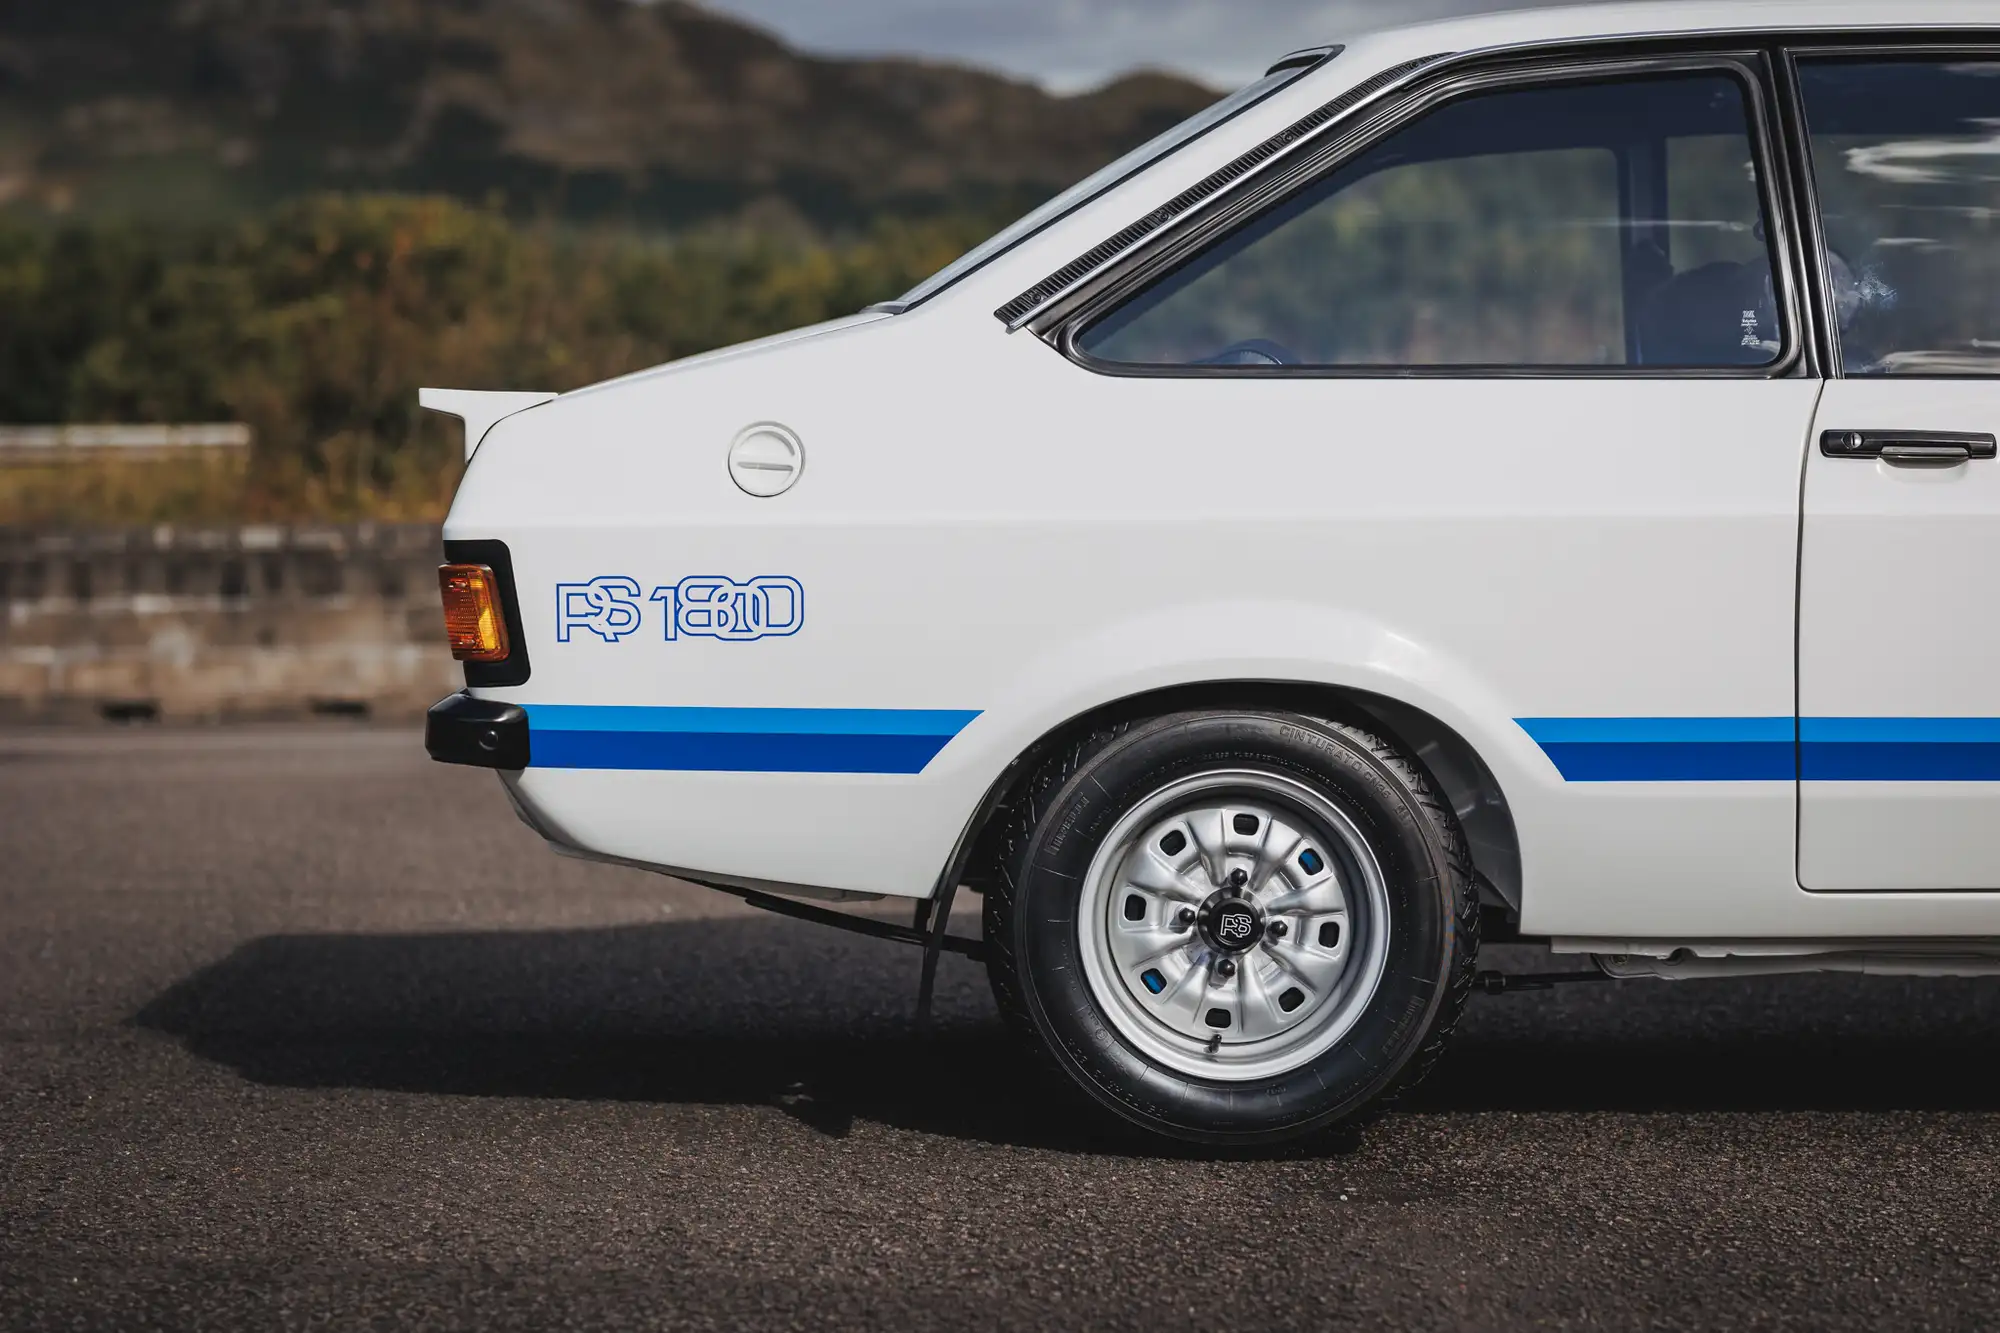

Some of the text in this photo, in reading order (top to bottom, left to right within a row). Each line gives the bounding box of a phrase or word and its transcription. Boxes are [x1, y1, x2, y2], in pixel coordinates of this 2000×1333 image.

[556, 575, 804, 642] RS 1800
[1279, 724, 1363, 771] CINTURATO
[1220, 913, 1252, 938] RS
